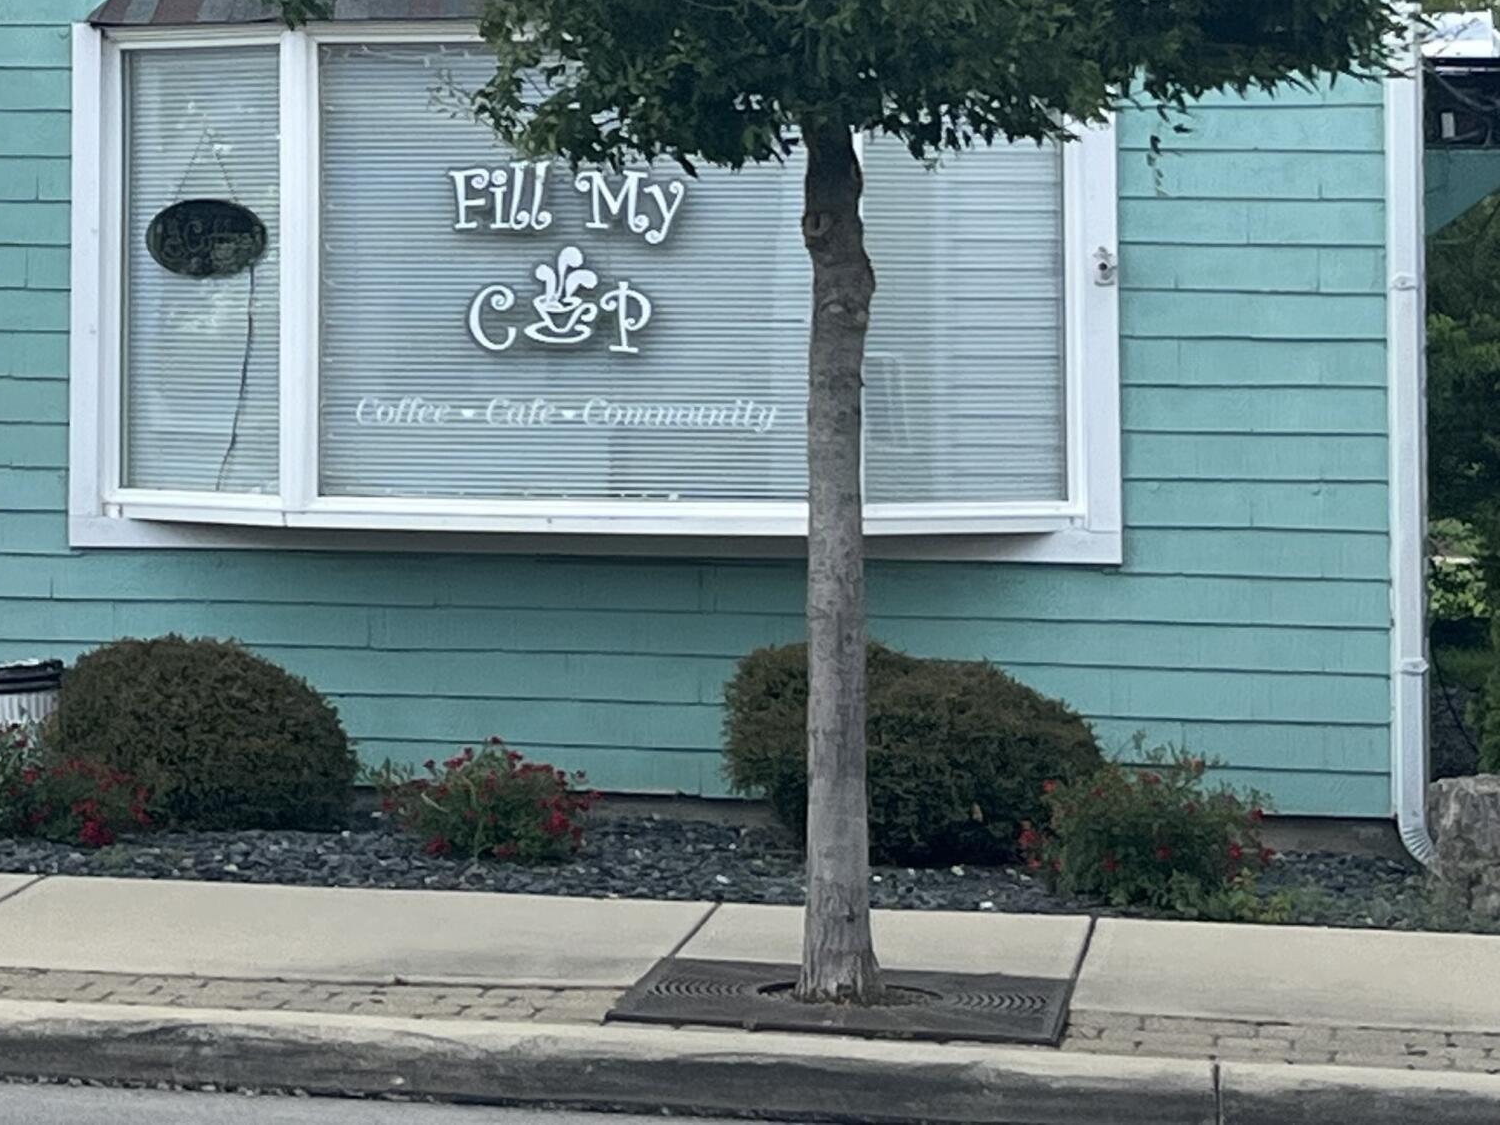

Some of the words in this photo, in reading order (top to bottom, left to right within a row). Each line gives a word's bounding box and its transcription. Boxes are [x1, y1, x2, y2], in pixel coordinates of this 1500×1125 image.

[448, 160, 552, 230] Fill
[575, 170, 684, 244] My
[356, 396, 450, 426] Coffee
[485, 397, 556, 426] Cafe
[582, 396, 777, 433] Community
